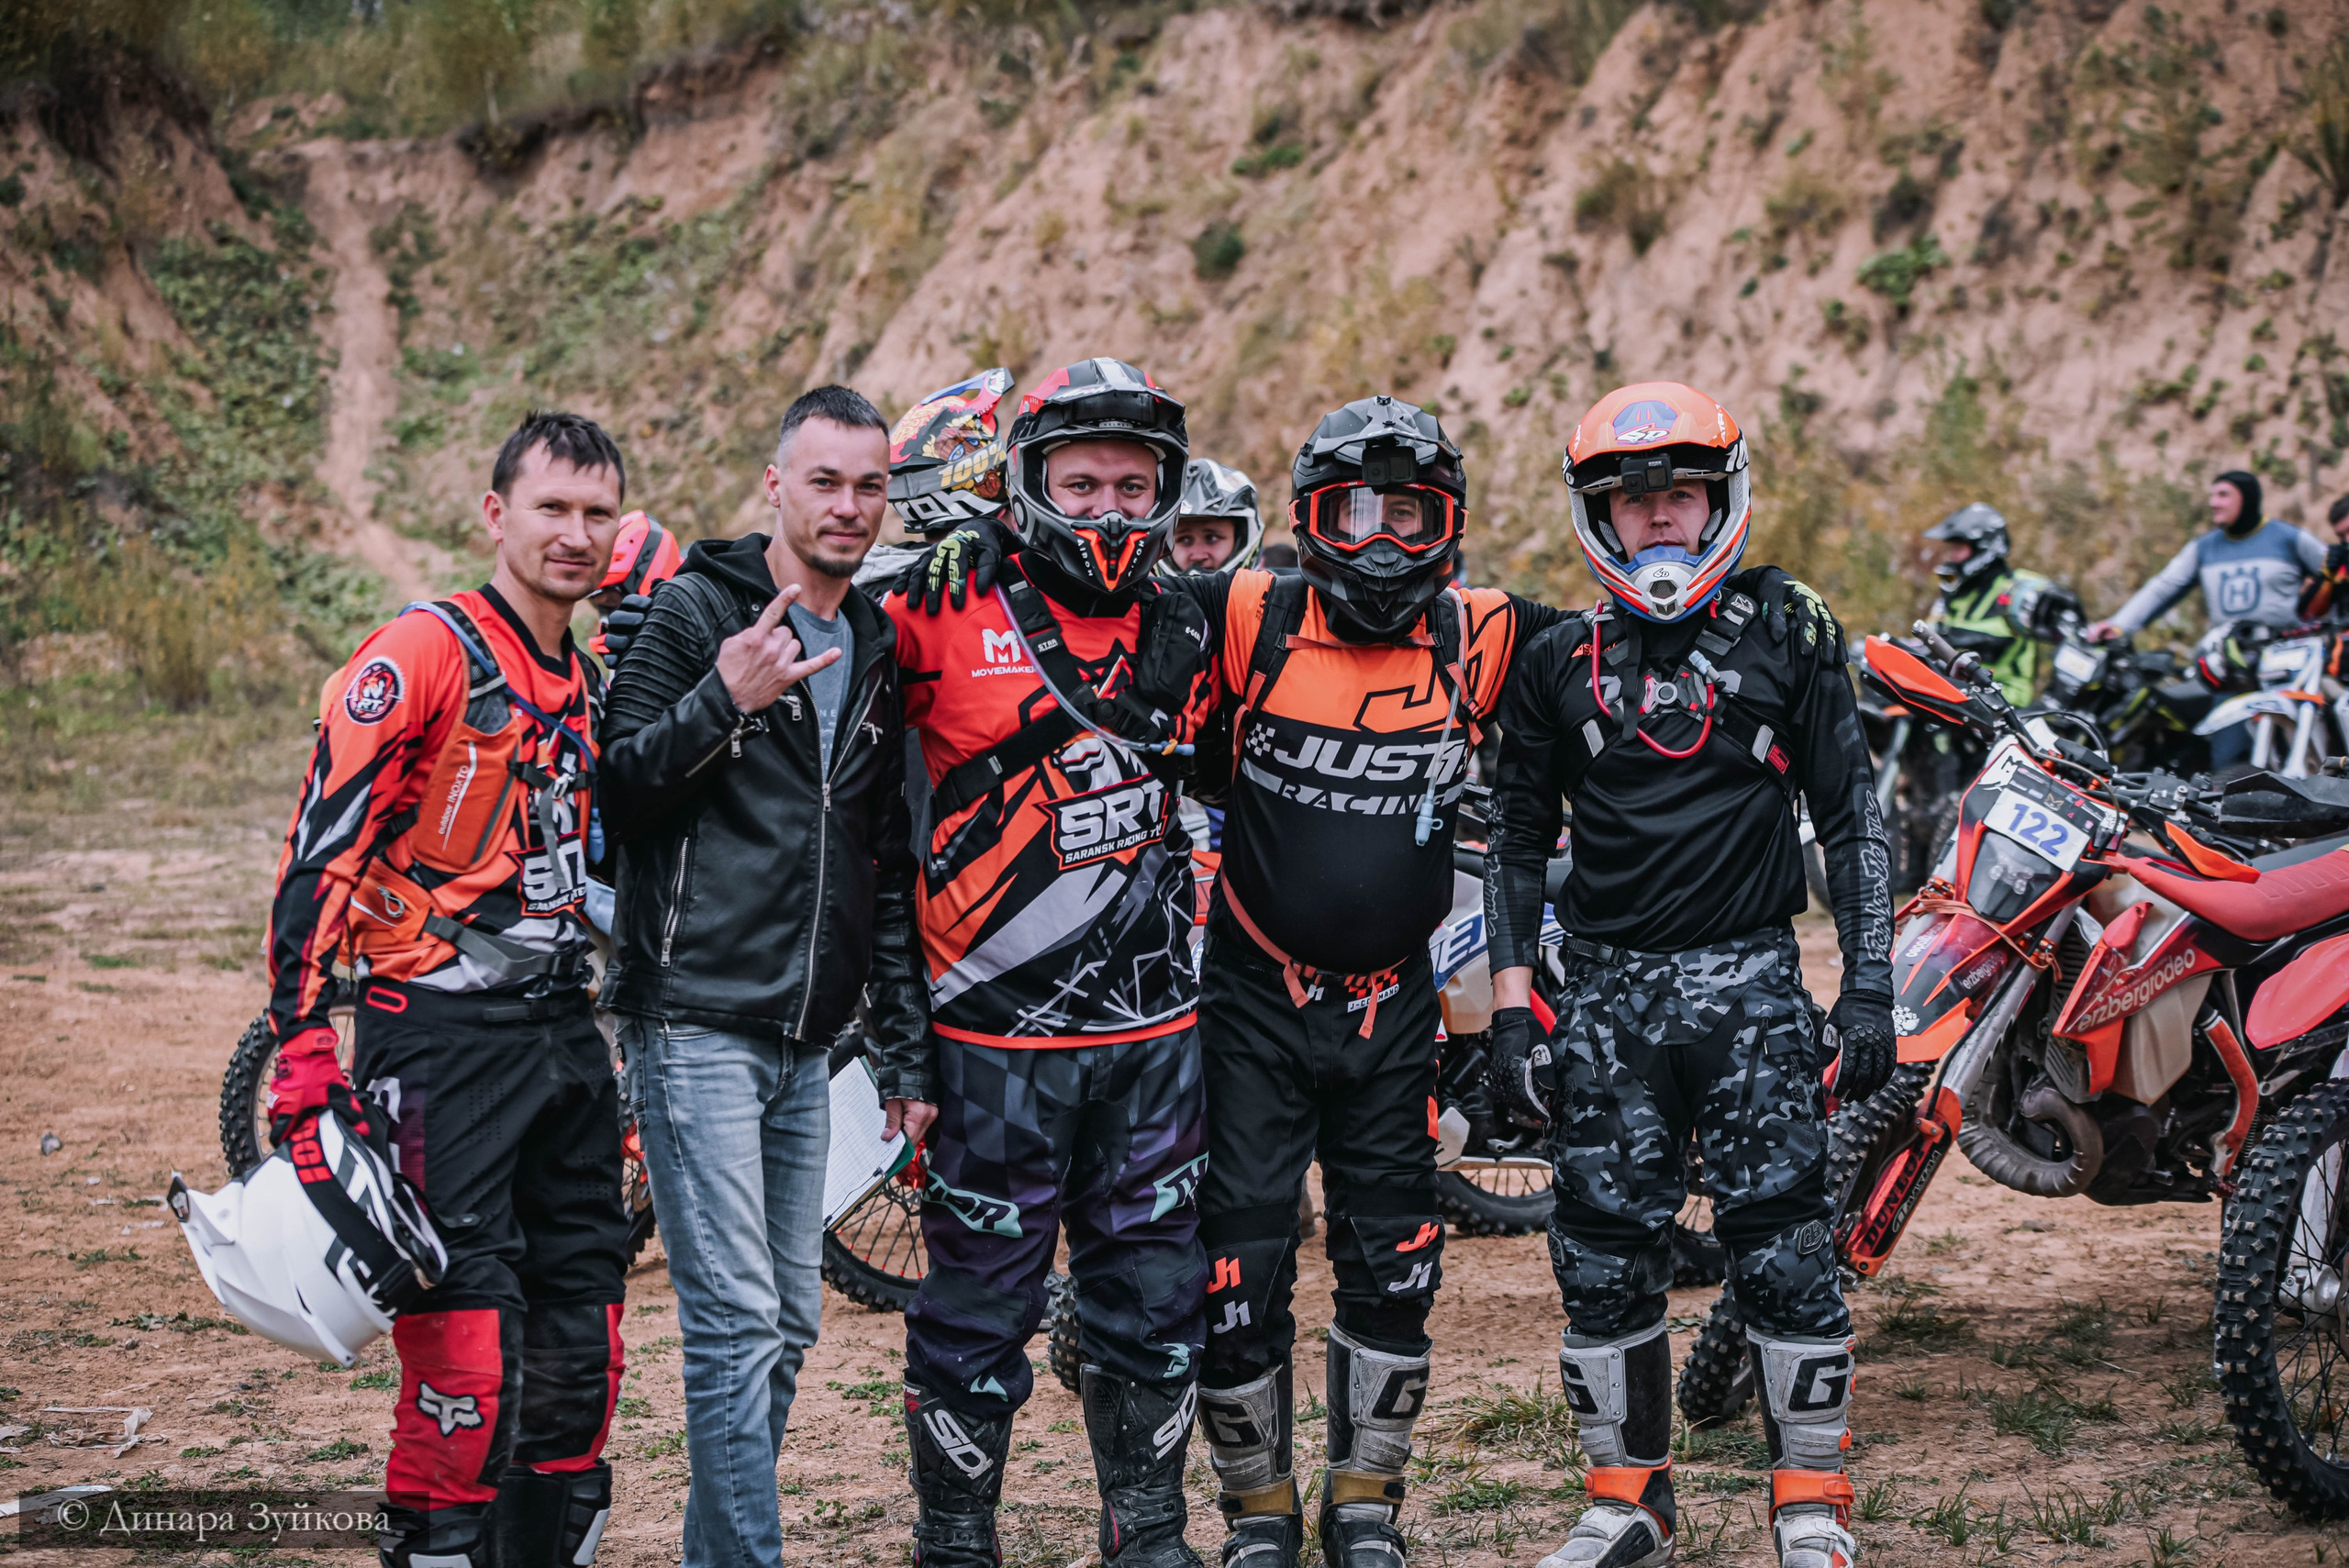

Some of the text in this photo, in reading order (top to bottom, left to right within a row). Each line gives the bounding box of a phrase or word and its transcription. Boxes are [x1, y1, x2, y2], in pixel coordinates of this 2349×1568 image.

[938, 439, 1007, 488] 100%
[1058, 778, 1164, 851] SRT
[2008, 803, 2069, 858] 122
[1064, 841, 1115, 863] SARANSK
[2077, 949, 2196, 1032] erzbergrodeo
